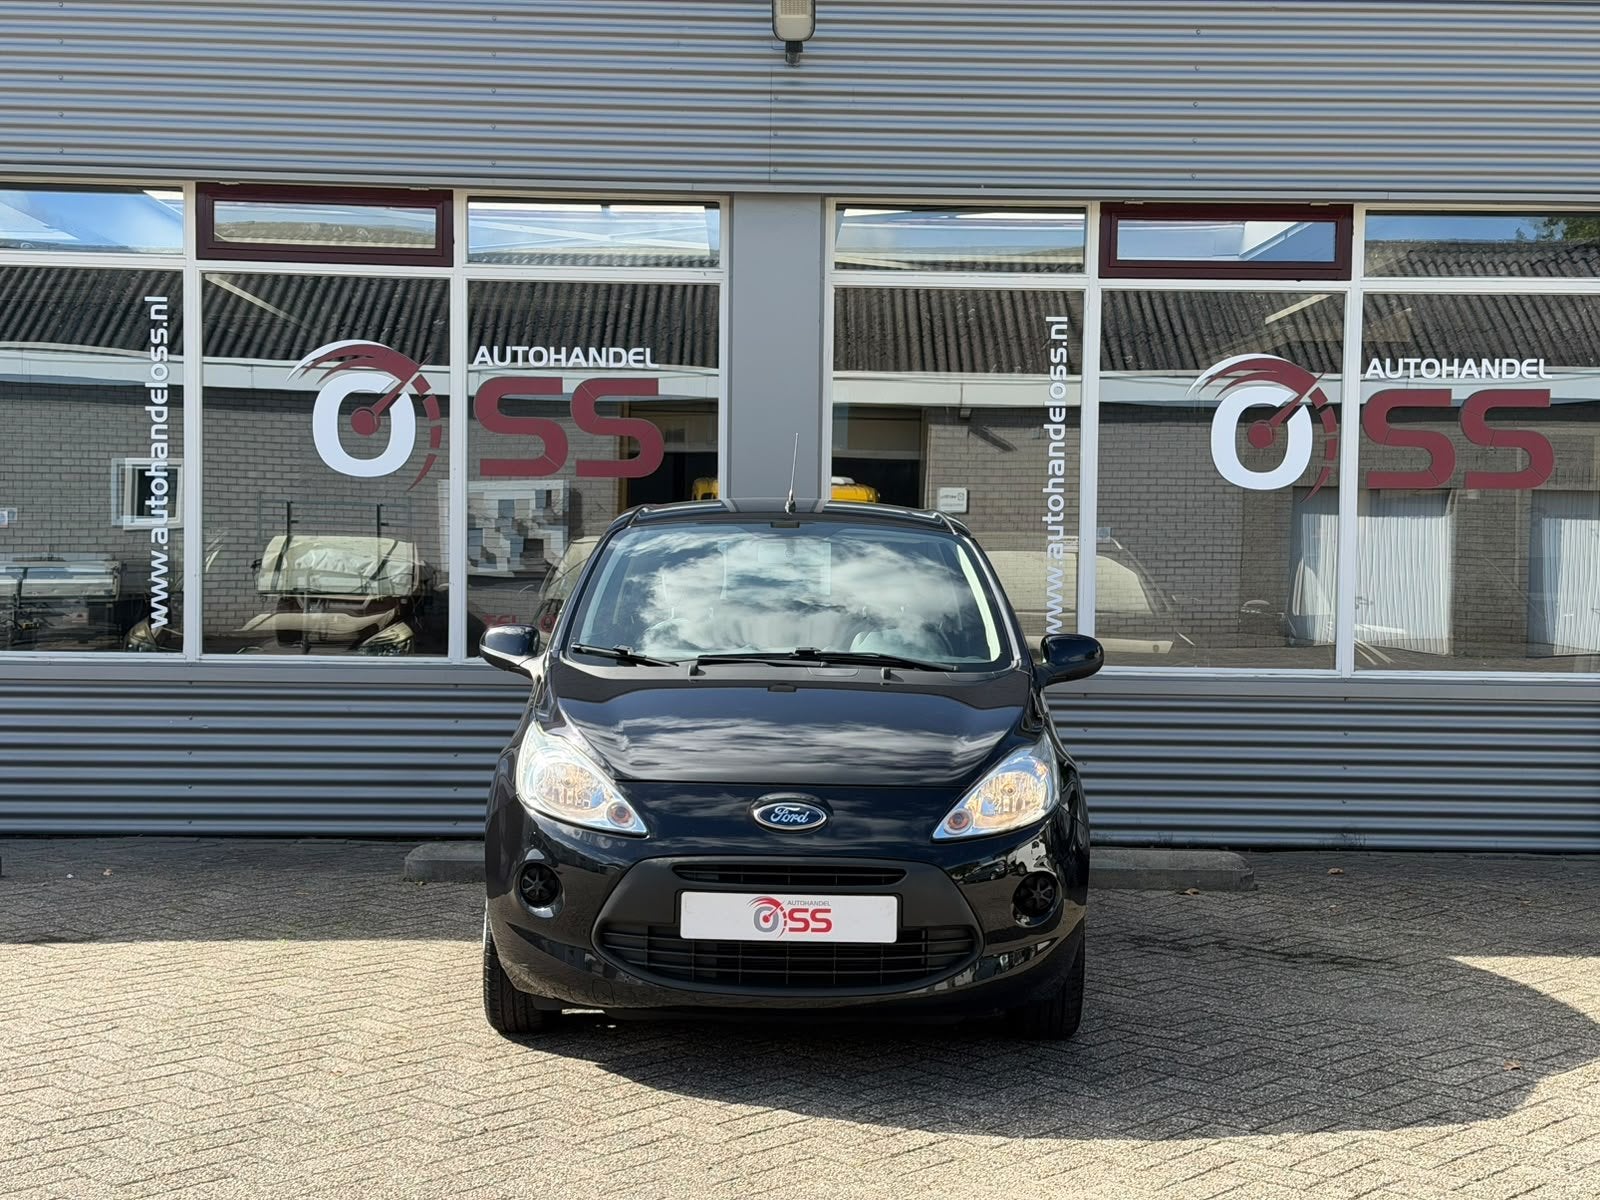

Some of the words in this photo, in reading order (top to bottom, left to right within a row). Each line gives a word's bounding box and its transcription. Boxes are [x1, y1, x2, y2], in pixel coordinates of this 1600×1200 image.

[472, 345, 659, 368] AUTOHANDEL
[1365, 358, 1552, 379] AUTOHANDEL
[144, 296, 169, 628] www.autohandeloss.nl
[770, 806, 809, 824] Ford
